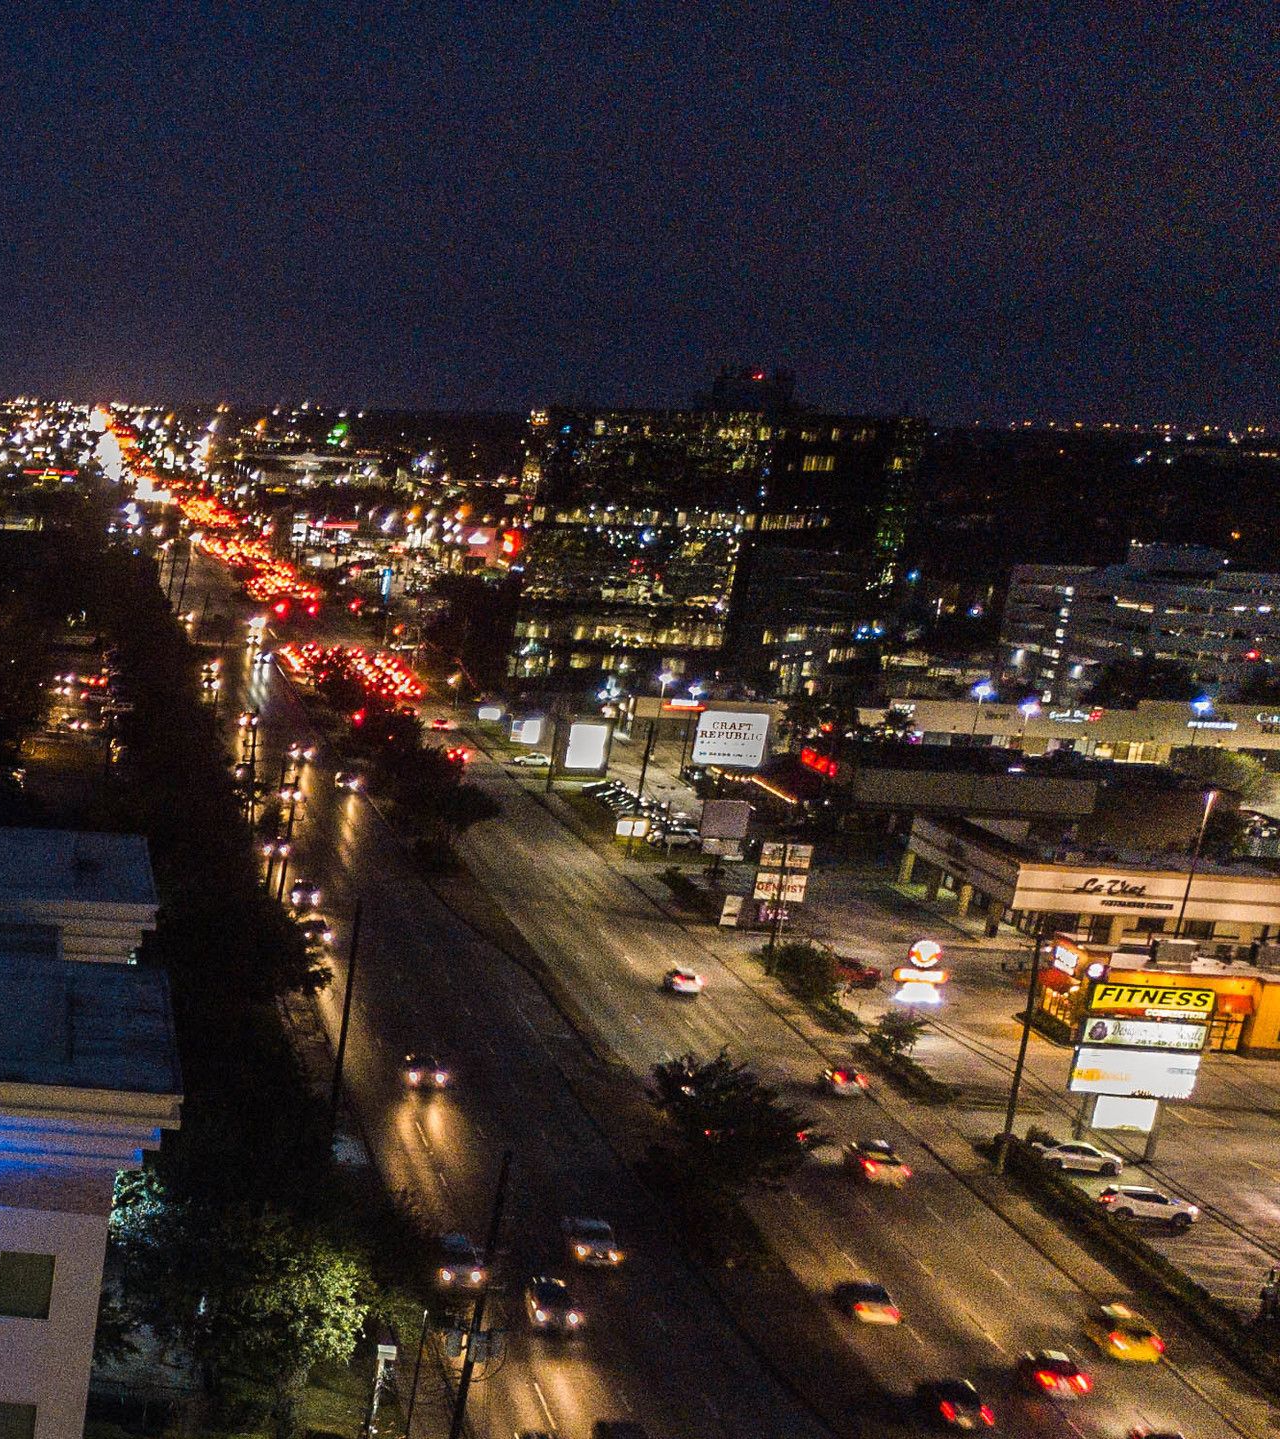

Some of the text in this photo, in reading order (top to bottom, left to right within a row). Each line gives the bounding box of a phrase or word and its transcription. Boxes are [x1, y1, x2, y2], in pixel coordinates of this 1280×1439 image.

[712, 721, 753, 731] CRAFT
[700, 730, 763, 741] REPUBLIC
[1098, 987, 1211, 1007] FITNESS
